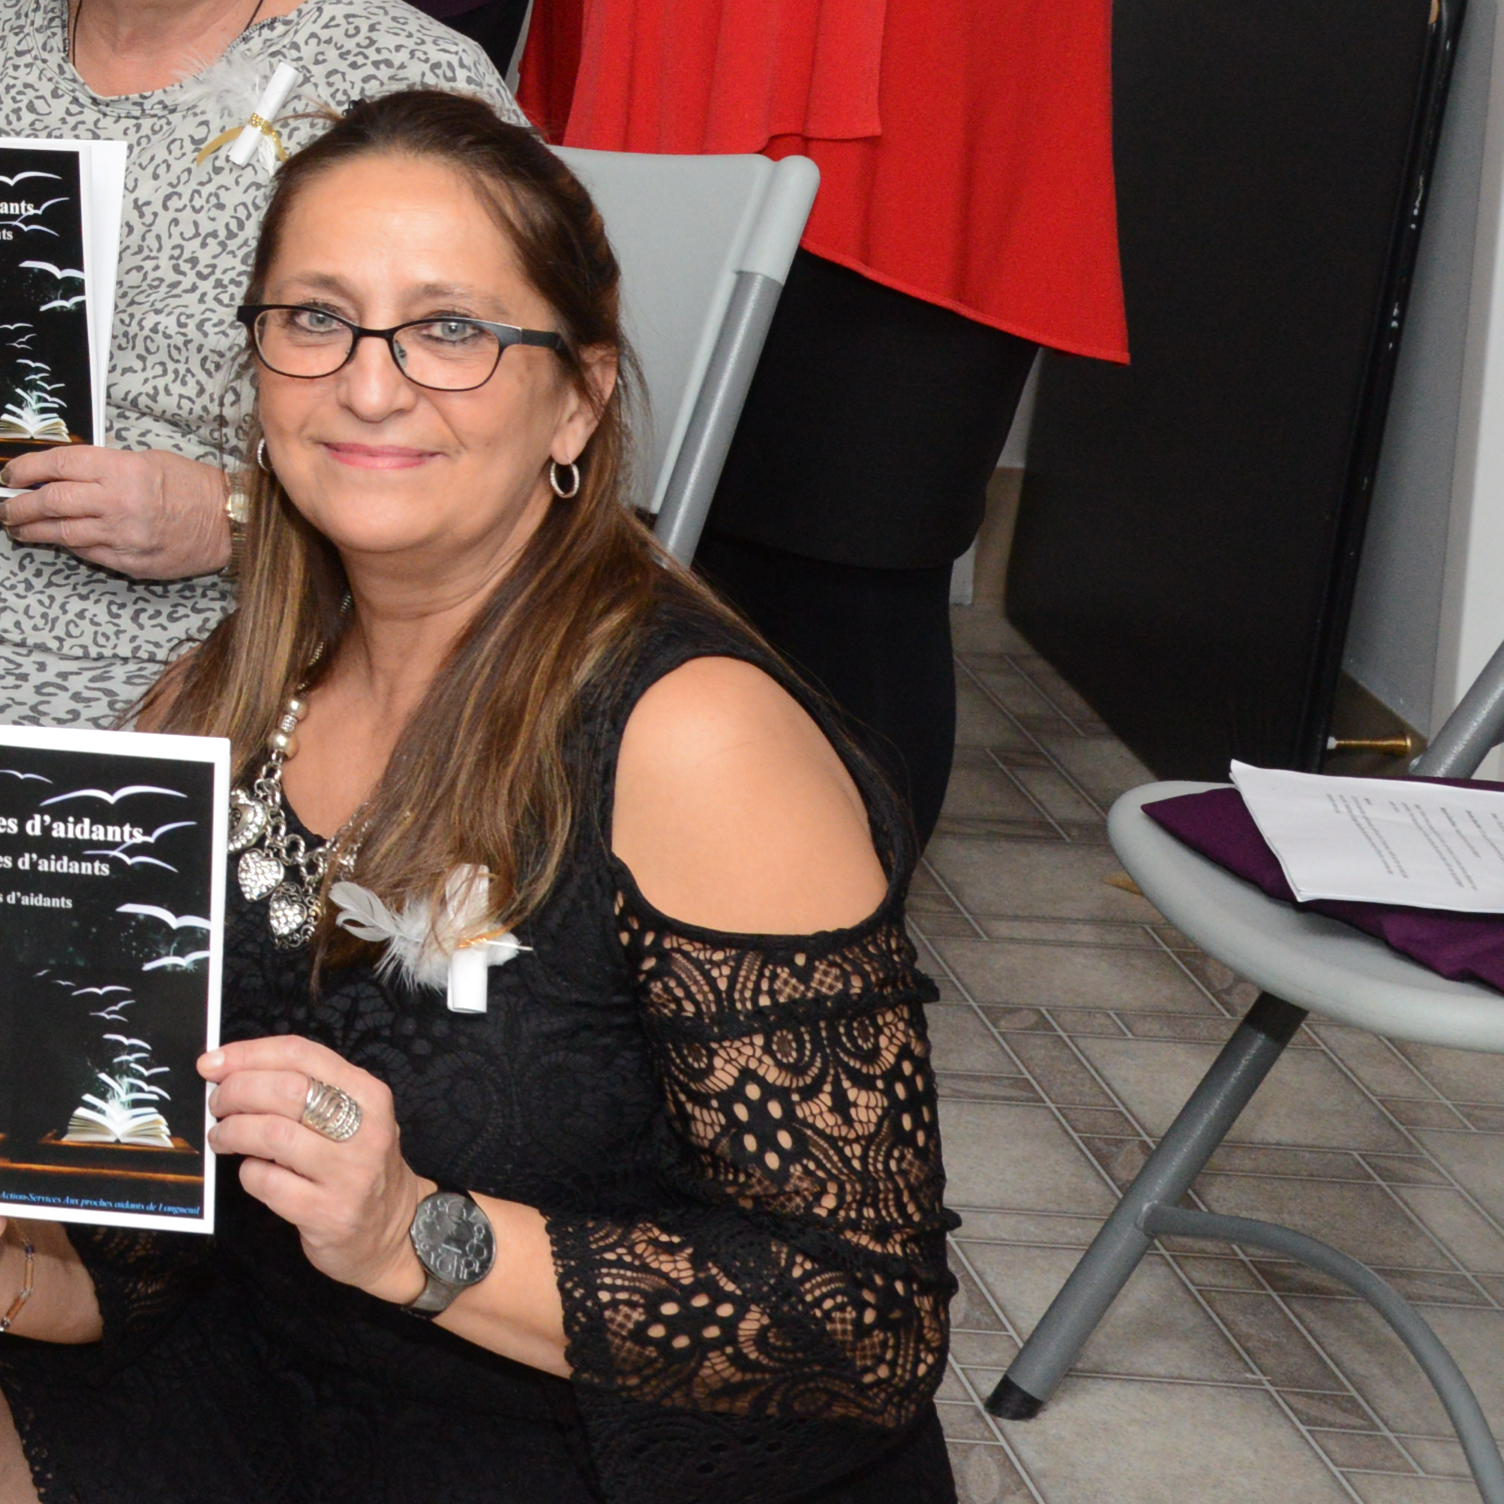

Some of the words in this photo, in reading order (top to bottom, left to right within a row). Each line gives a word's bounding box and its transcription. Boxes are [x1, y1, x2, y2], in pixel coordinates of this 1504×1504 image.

[25, 813, 145, 844] d'aidants
[18, 852, 111, 878] d'aidants
[6, 890, 73, 910] d'aidants
